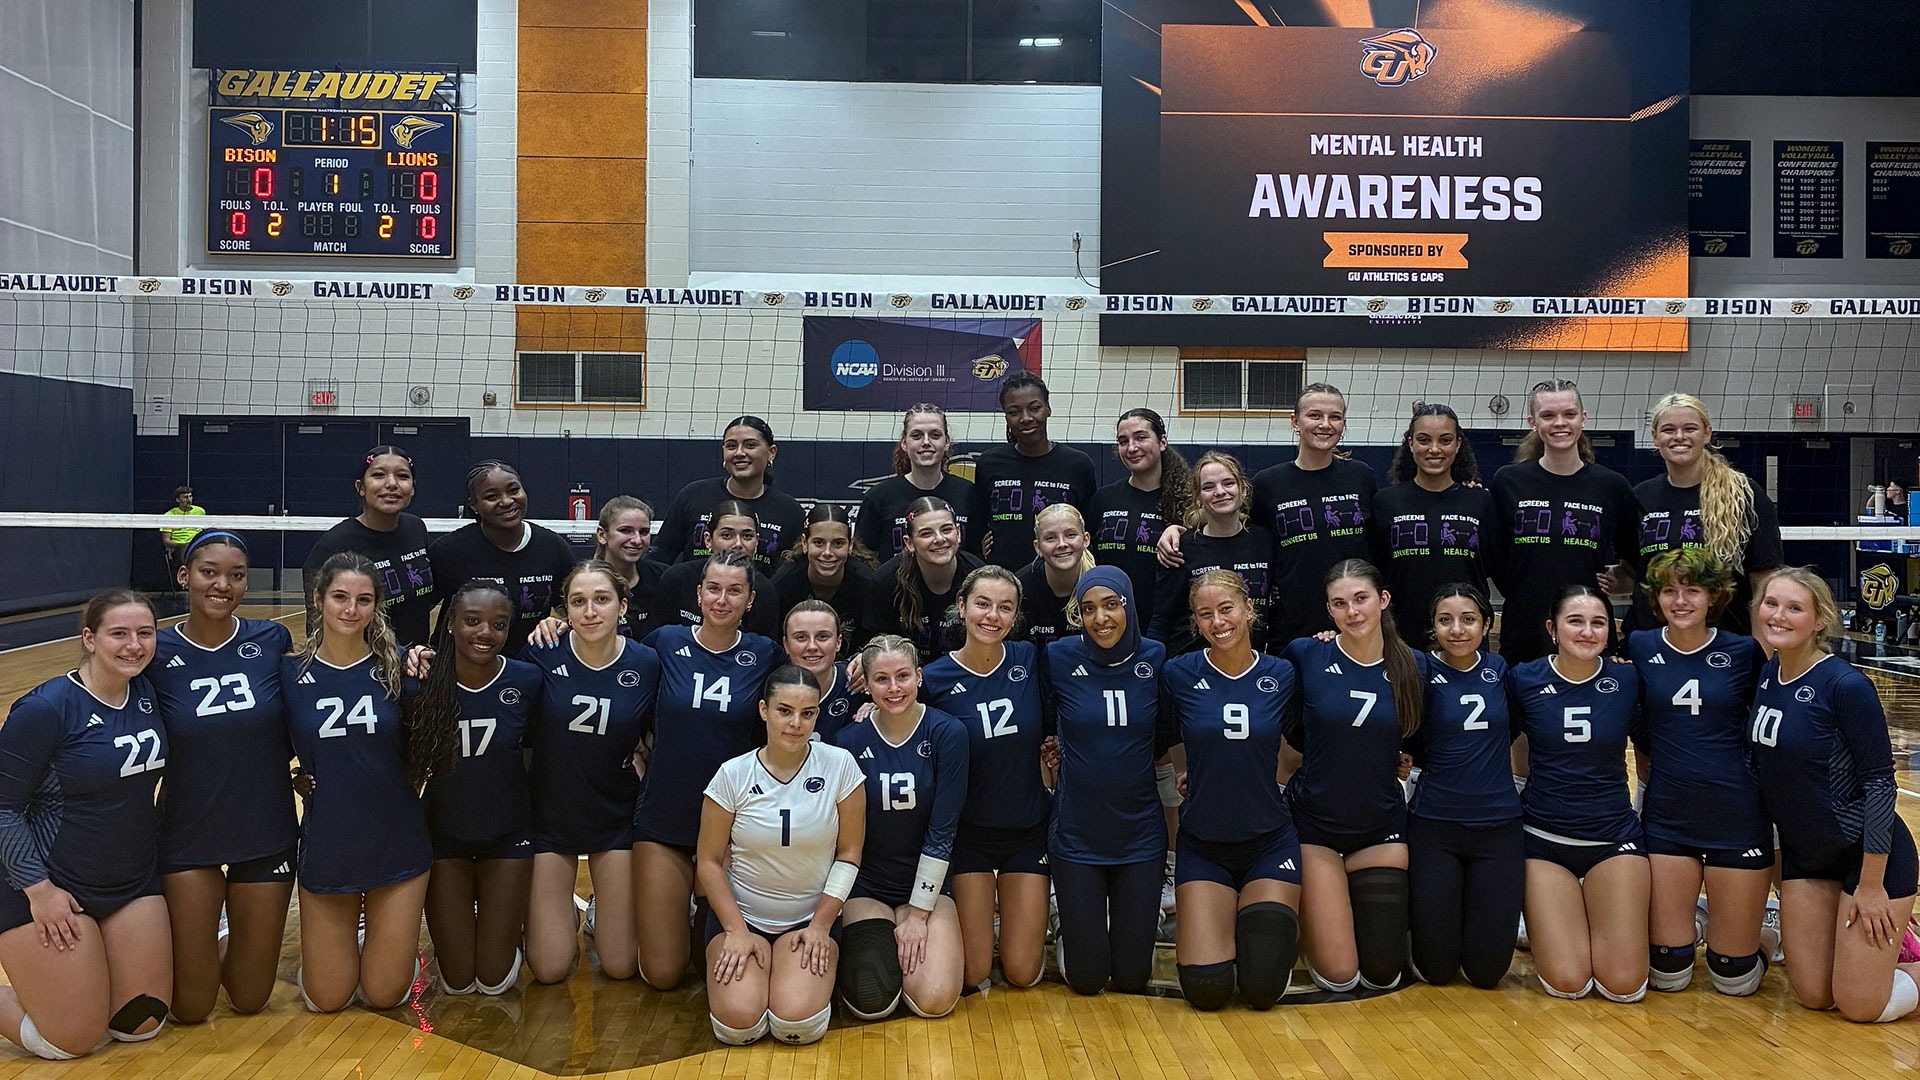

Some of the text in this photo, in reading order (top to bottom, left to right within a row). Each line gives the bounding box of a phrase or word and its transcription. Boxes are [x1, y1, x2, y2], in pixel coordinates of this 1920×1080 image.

[217, 70, 447, 101] GALLAUDET
[321, 115, 376, 145] 1:15
[1310, 134, 1483, 158] MENTAL HEALTH
[224, 148, 277, 163] BISON
[386, 152, 438, 167] LIONS
[314, 158, 349, 169] PERIOD
[1777, 161, 1839, 169] CONFERENCE
[1689, 168, 1743, 176] CHAMPIONS
[1780, 169, 1836, 177] CHAMPIONS
[254, 167, 273, 197] 0
[419, 171, 438, 200] 0
[1248, 173, 1544, 222] AWARENESS
[220, 200, 289, 211] FOULS T.O.L.
[298, 202, 364, 213] PLAYER FOUL
[373, 203, 441, 214] T.O.L. FOULS
[231, 212, 247, 235] 0
[267, 212, 282, 236] 2
[379, 215, 393, 238] 2
[421, 215, 437, 239] 0
[219, 240, 251, 250] SCORE
[313, 242, 347, 252] MATCH
[409, 244, 441, 254] SCORE
[1348, 244, 1444, 258] SPONSORED BY
[1347, 272, 1444, 283] GU ATHLETICS & CAPS
[0, 275, 119, 293] GALLAUDET
[181, 279, 252, 296] BISON
[313, 281, 434, 300] GALLAUDET
[495, 286, 566, 303] BISON
[625, 288, 744, 306] GALLAUDET
[804, 291, 873, 308] BISON
[931, 293, 1046, 311] GALLAUDET
[1106, 295, 1174, 312] BISON
[1231, 296, 1347, 313] GALLAUDET
[1407, 297, 1475, 314] BISON
[1532, 298, 1646, 315] GALLAUDET
[1705, 299, 1772, 316] BISON
[836, 362, 878, 377] NCAA
[882, 363, 945, 377] Division III
[315, 391, 333, 405] EXIT
[1796, 403, 1813, 417] EXIT
[1034, 480, 1049, 488] FACE
[1056, 482, 1070, 490] FACE
[1277, 499, 1308, 511] SCREENS
[1321, 495, 1338, 503] FACE
[1518, 500, 1550, 508] SCREENS
[1102, 510, 1129, 518] SCREENS
[1563, 501, 1581, 510] FACE
[1588, 504, 1603, 514] FACE
[1393, 514, 1426, 523] SCREENS
[1466, 516, 1480, 526] FACE
[767, 523, 782, 532] FACE
[1330, 527, 1364, 537] HEALS US
[1280, 532, 1318, 547] CONNECT US
[1540, 536, 1551, 544] US
[1563, 537, 1598, 549] HEALS US
[400, 552, 415, 562] FACE
[1443, 548, 1469, 556] HEALS
[519, 576, 536, 584] FACE
[396, 594, 405, 603] US
[190, 672, 256, 717] 23
[692, 672, 732, 712] 14
[1671, 678, 1703, 716] 4
[568, 694, 611, 735] 21
[1102, 689, 1128, 727] 11
[1349, 689, 1378, 727] 7
[1459, 693, 1489, 731] 2
[315, 695, 378, 739] 24
[976, 697, 1019, 740] 12
[1223, 703, 1250, 740] 9
[1563, 706, 1592, 743] 5
[1751, 704, 1784, 748] 10
[458, 717, 498, 758] 17
[113, 728, 166, 778] 22
[879, 772, 916, 811] 13
[779, 808, 791, 847] 1
